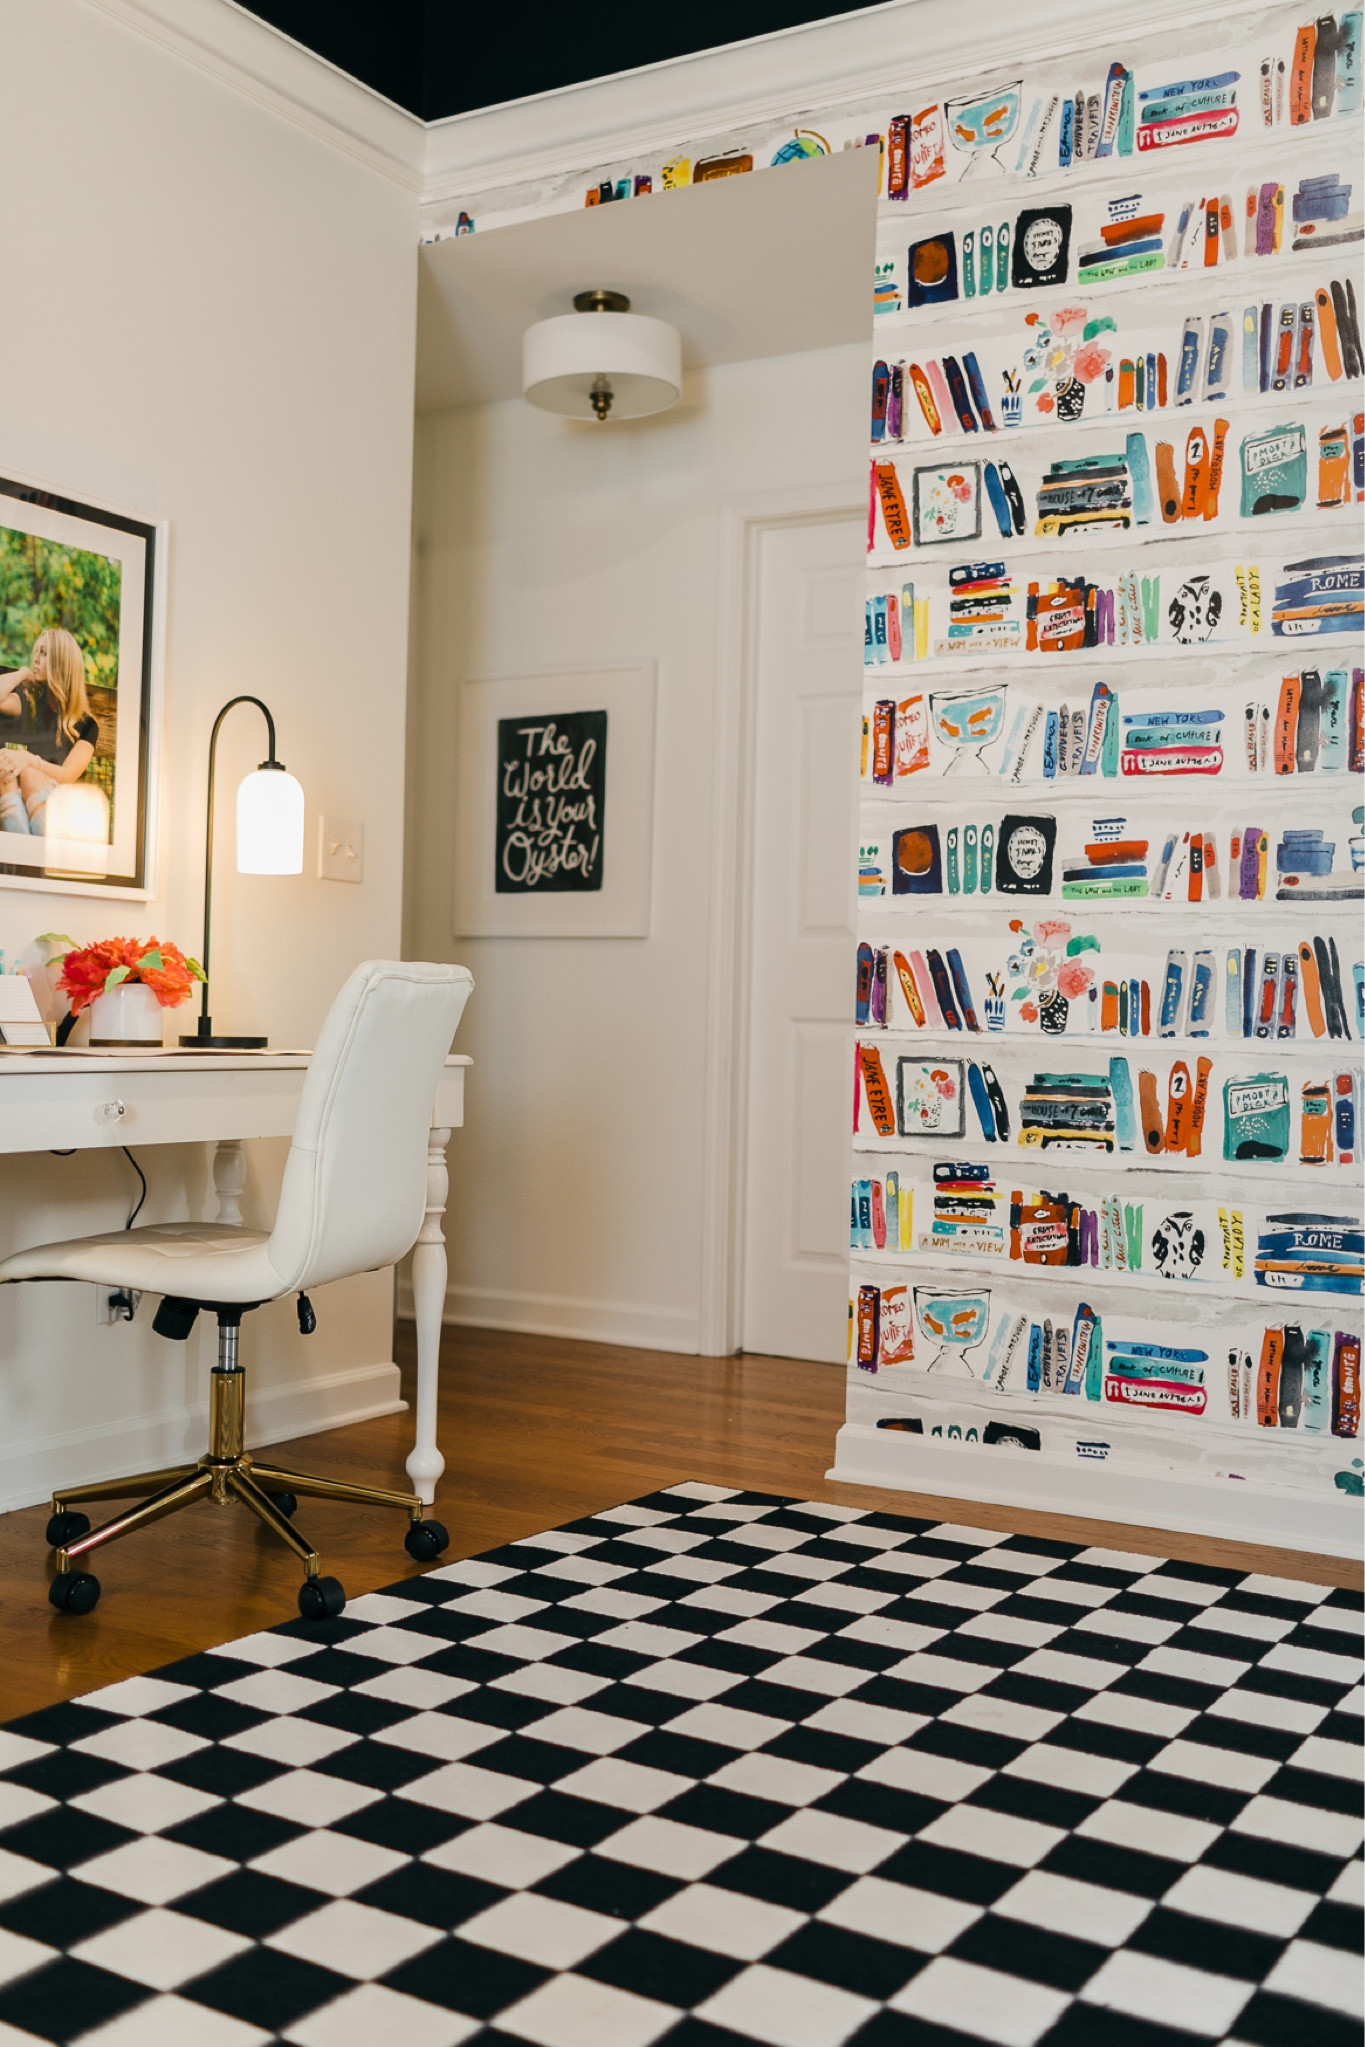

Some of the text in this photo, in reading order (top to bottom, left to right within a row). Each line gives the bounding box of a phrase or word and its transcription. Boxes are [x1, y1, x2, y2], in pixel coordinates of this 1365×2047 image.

[1163, 78, 1219, 98] NEW YORK
[1087, 99, 1100, 154] TRAVELS
[1165, 127, 1188, 140] JANE
[1139, 258, 1158, 269] LADY
[1208, 434, 1224, 491] MODERN ART
[877, 473, 904, 536] JANE EYRE
[1248, 571, 1261, 606] LADY
[1310, 572, 1361, 591] ROME
[992, 636, 1021, 649] VIEW
[1147, 713, 1203, 726] NEW YORK
[516, 722, 572, 757] The
[1071, 715, 1084, 771] TRAVELS
[503, 738, 597, 798] World
[1148, 758, 1173, 767] JANE
[507, 796, 545, 832] is
[503, 824, 600, 886] Oyster!
[1123, 885, 1142, 893] LADY
[862, 1056, 889, 1121] JANE EYRE
[1192, 1072, 1206, 1128] MODERN ART
[976, 1242, 1005, 1254] VIEW
[1231, 1215, 1244, 1252] LADY
[1292, 1232, 1344, 1249] ROME
[1055, 1331, 1067, 1386] TRAVELS
[1131, 1345, 1188, 1361] NEW YORK
[1132, 1388, 1156, 1400] JANE
